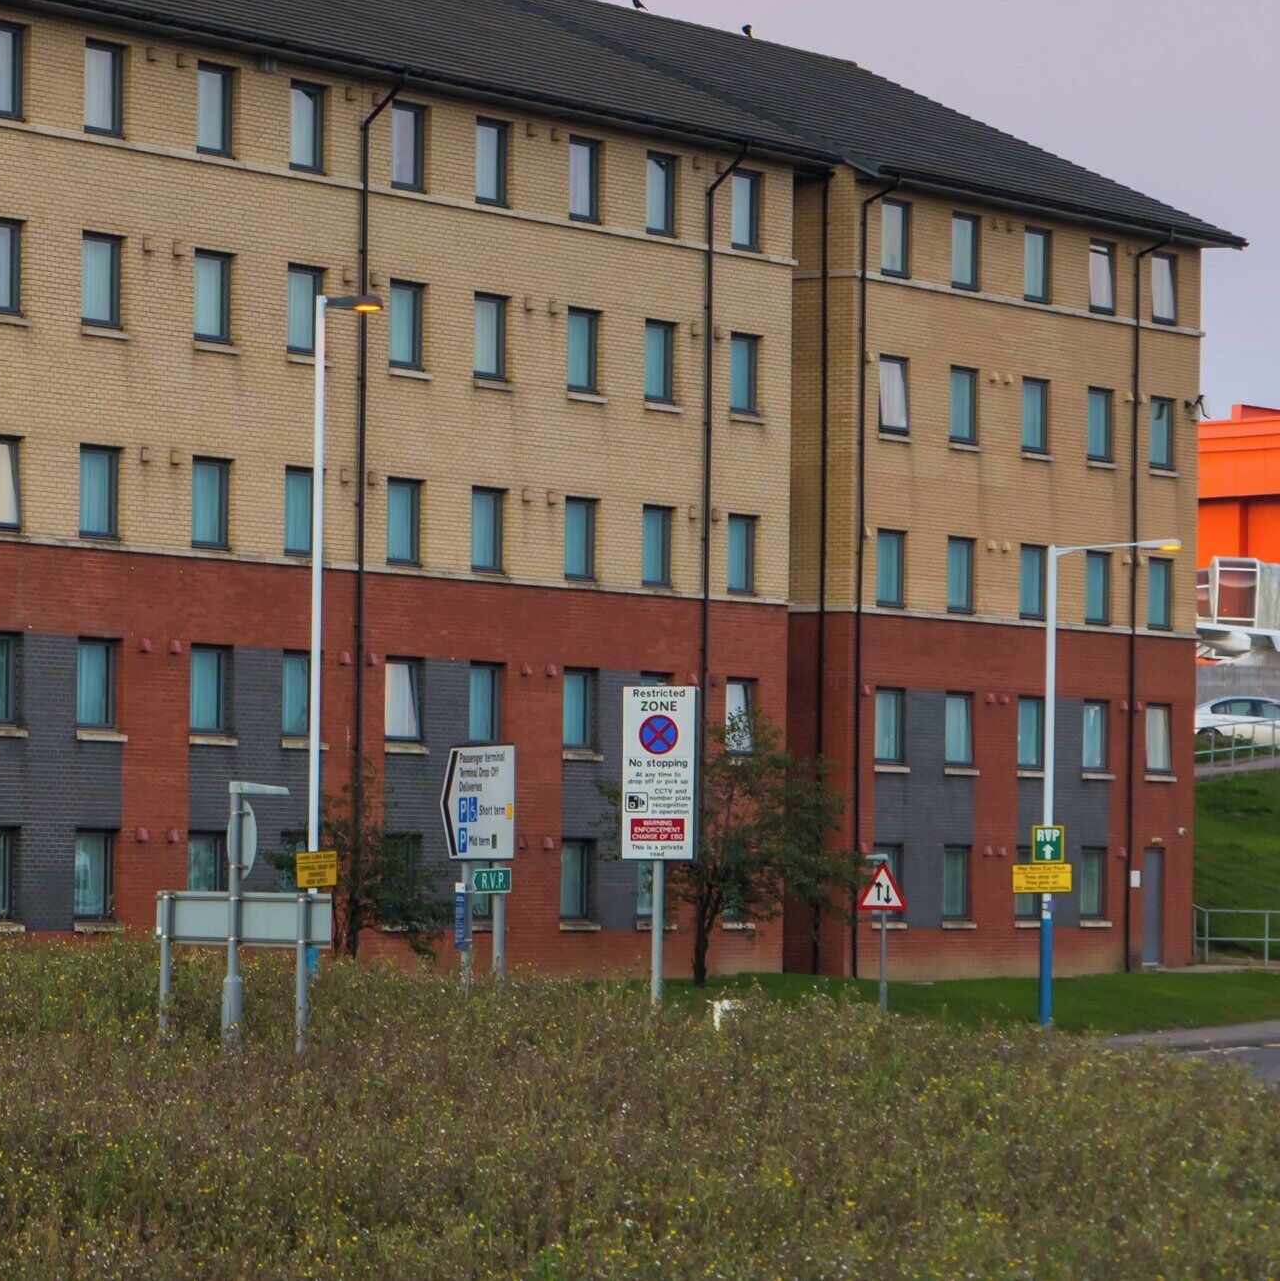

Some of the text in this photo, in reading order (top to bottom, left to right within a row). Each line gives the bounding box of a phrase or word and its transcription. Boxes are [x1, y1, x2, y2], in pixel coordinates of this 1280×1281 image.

[633, 689, 686, 698] Restricted
[640, 701, 678, 711] ZONE
[459, 751, 505, 765] Passenger terminal
[629, 759, 688, 768] No stopping
[459, 766, 499, 779] Terminal Drop Off
[459, 781, 483, 792] Deliveries
[479, 804, 493, 816] Short
[494, 806, 506, 816] term
[468, 835, 478, 846] Mid
[478, 836, 490, 846] term
[1036, 829, 1061, 842] RVP
[481, 872, 506, 889] R.V.P.
